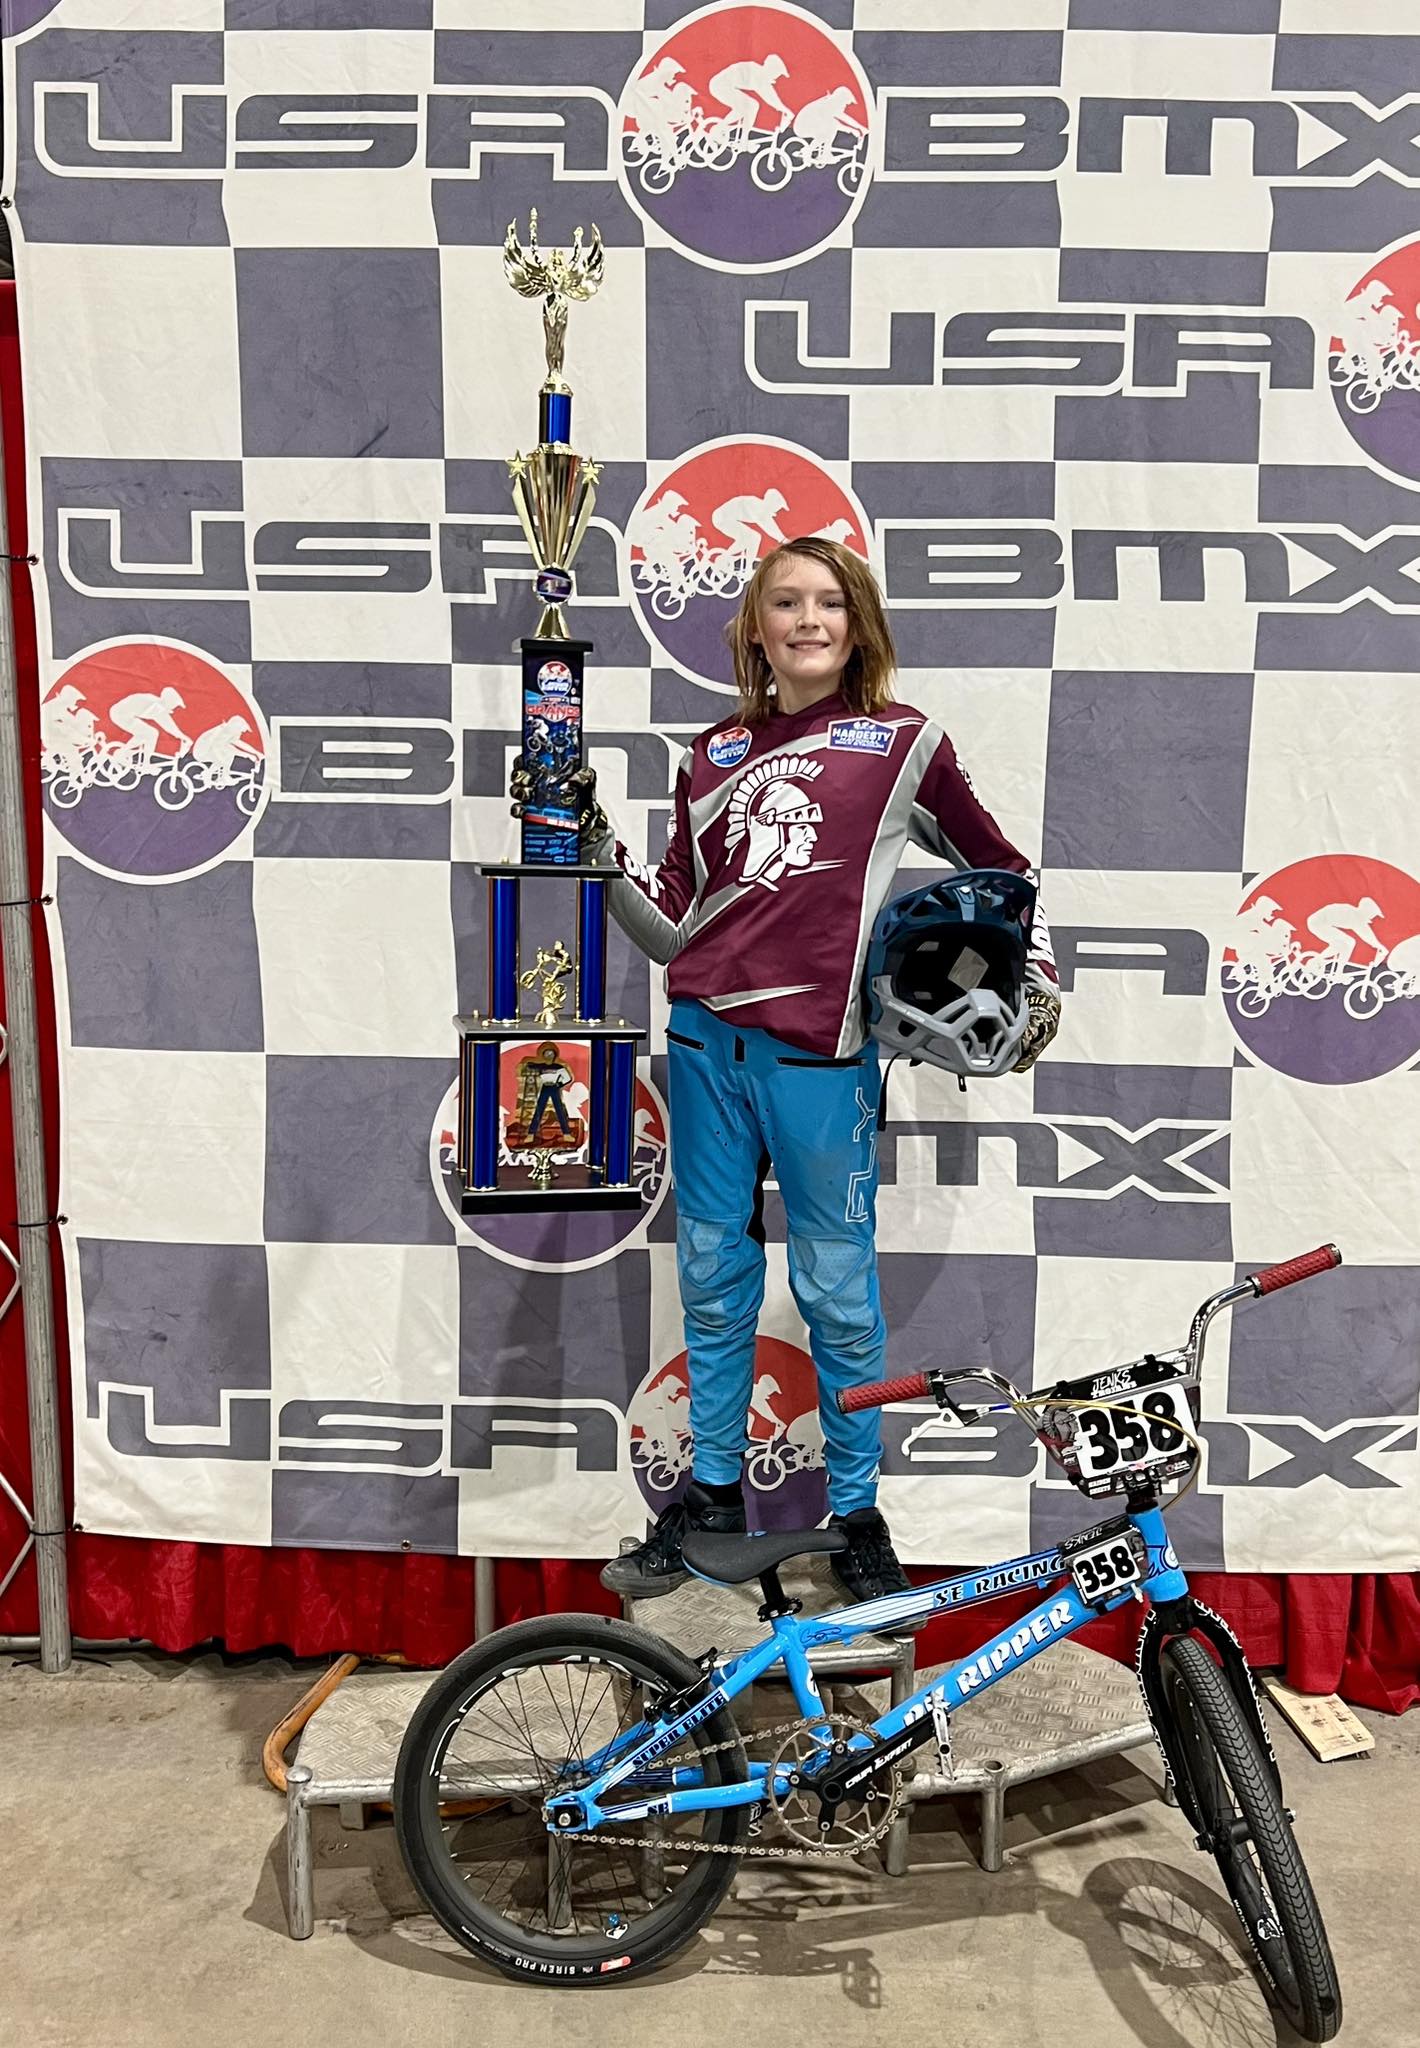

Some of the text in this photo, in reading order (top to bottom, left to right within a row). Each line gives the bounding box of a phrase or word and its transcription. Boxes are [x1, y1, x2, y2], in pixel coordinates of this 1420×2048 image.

[38, 86, 1420, 182] USA BMX
[749, 306, 1317, 393] USA
[63, 514, 1420, 606] USA BMX
[275, 721, 690, 798] BM
[832, 727, 891, 742] HARDESTY
[1026, 996, 1046, 1004] FIS
[874, 1120, 1232, 1198] MX
[1092, 1369, 1132, 1393] JENKS
[103, 1388, 621, 1474] USA
[1078, 1391, 1184, 1470] 358
[1064, 1527, 1103, 1550] JENKS
[1075, 1545, 1135, 1594] 358
[935, 1554, 1066, 1607] SE RACING
[956, 1600, 1075, 1696] RIPPER
[632, 1692, 727, 1769] SUPER ELITE
[647, 1801, 669, 1816] SE
[515, 1957, 536, 1971] PRO
[540, 1963, 576, 1975] SIREN
